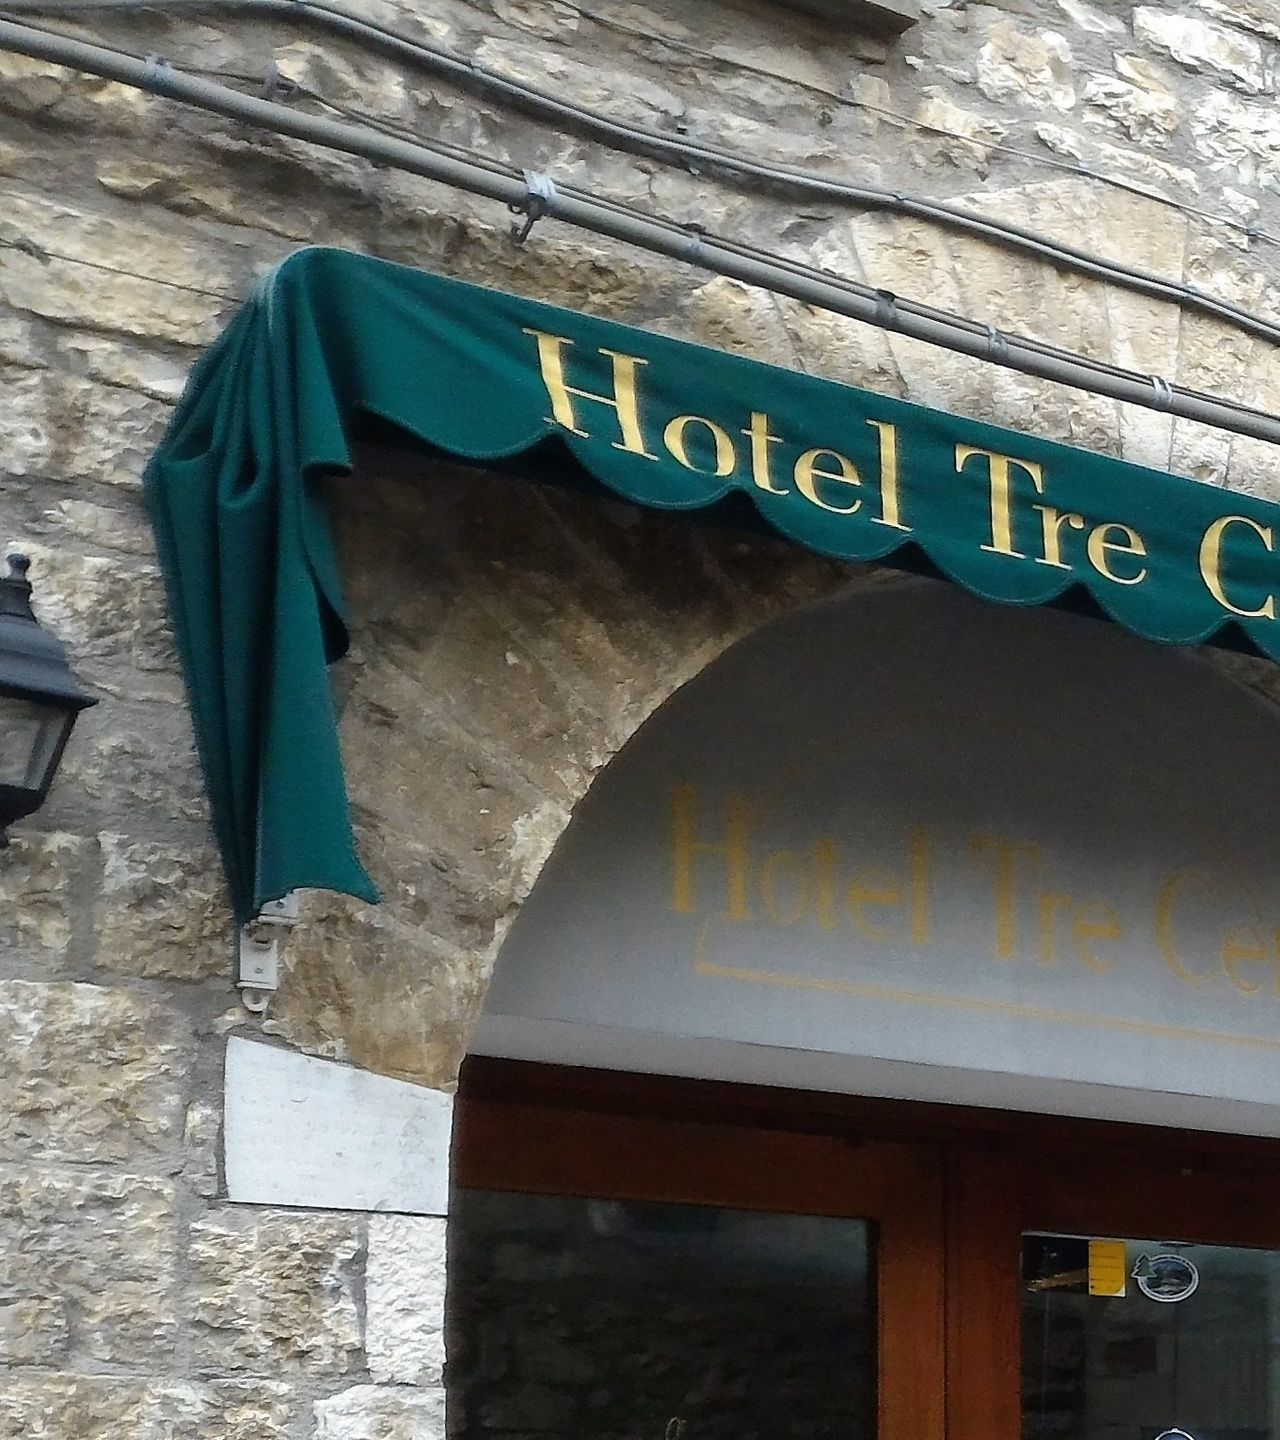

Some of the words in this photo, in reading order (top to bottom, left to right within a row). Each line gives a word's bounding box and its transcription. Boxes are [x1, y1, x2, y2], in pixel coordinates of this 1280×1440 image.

[522, 328, 913, 532] Hotel
[954, 442, 1147, 585] Tre
[669, 782, 932, 946] Hotel
[969, 833, 1124, 974] Tre
